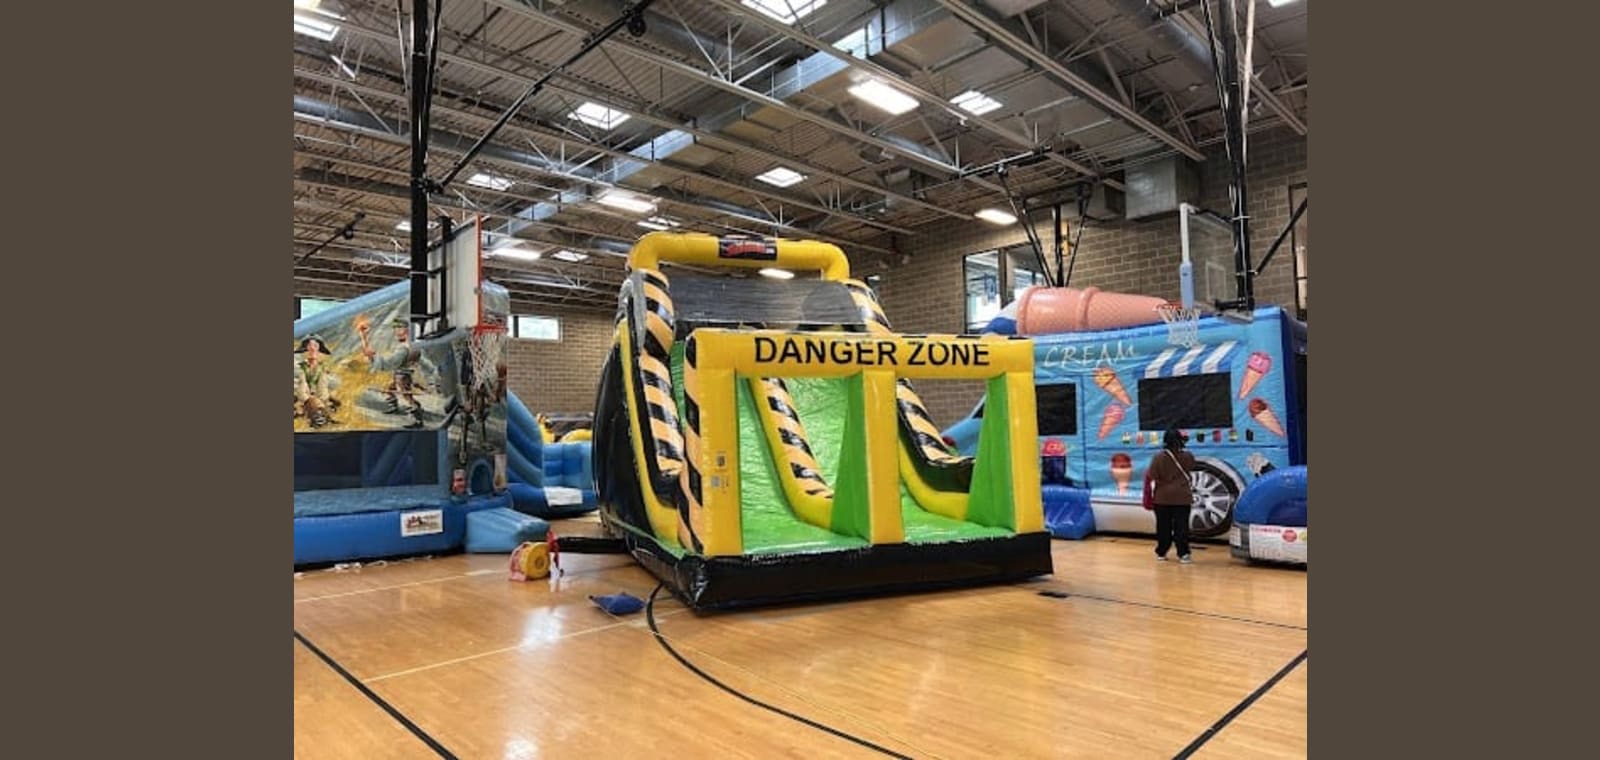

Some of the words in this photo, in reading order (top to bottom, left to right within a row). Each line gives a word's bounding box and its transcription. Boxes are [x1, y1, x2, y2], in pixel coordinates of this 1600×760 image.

[754, 337, 898, 366] DANGER
[907, 341, 990, 366] ZONE
[1043, 340, 1135, 369] CREAM
